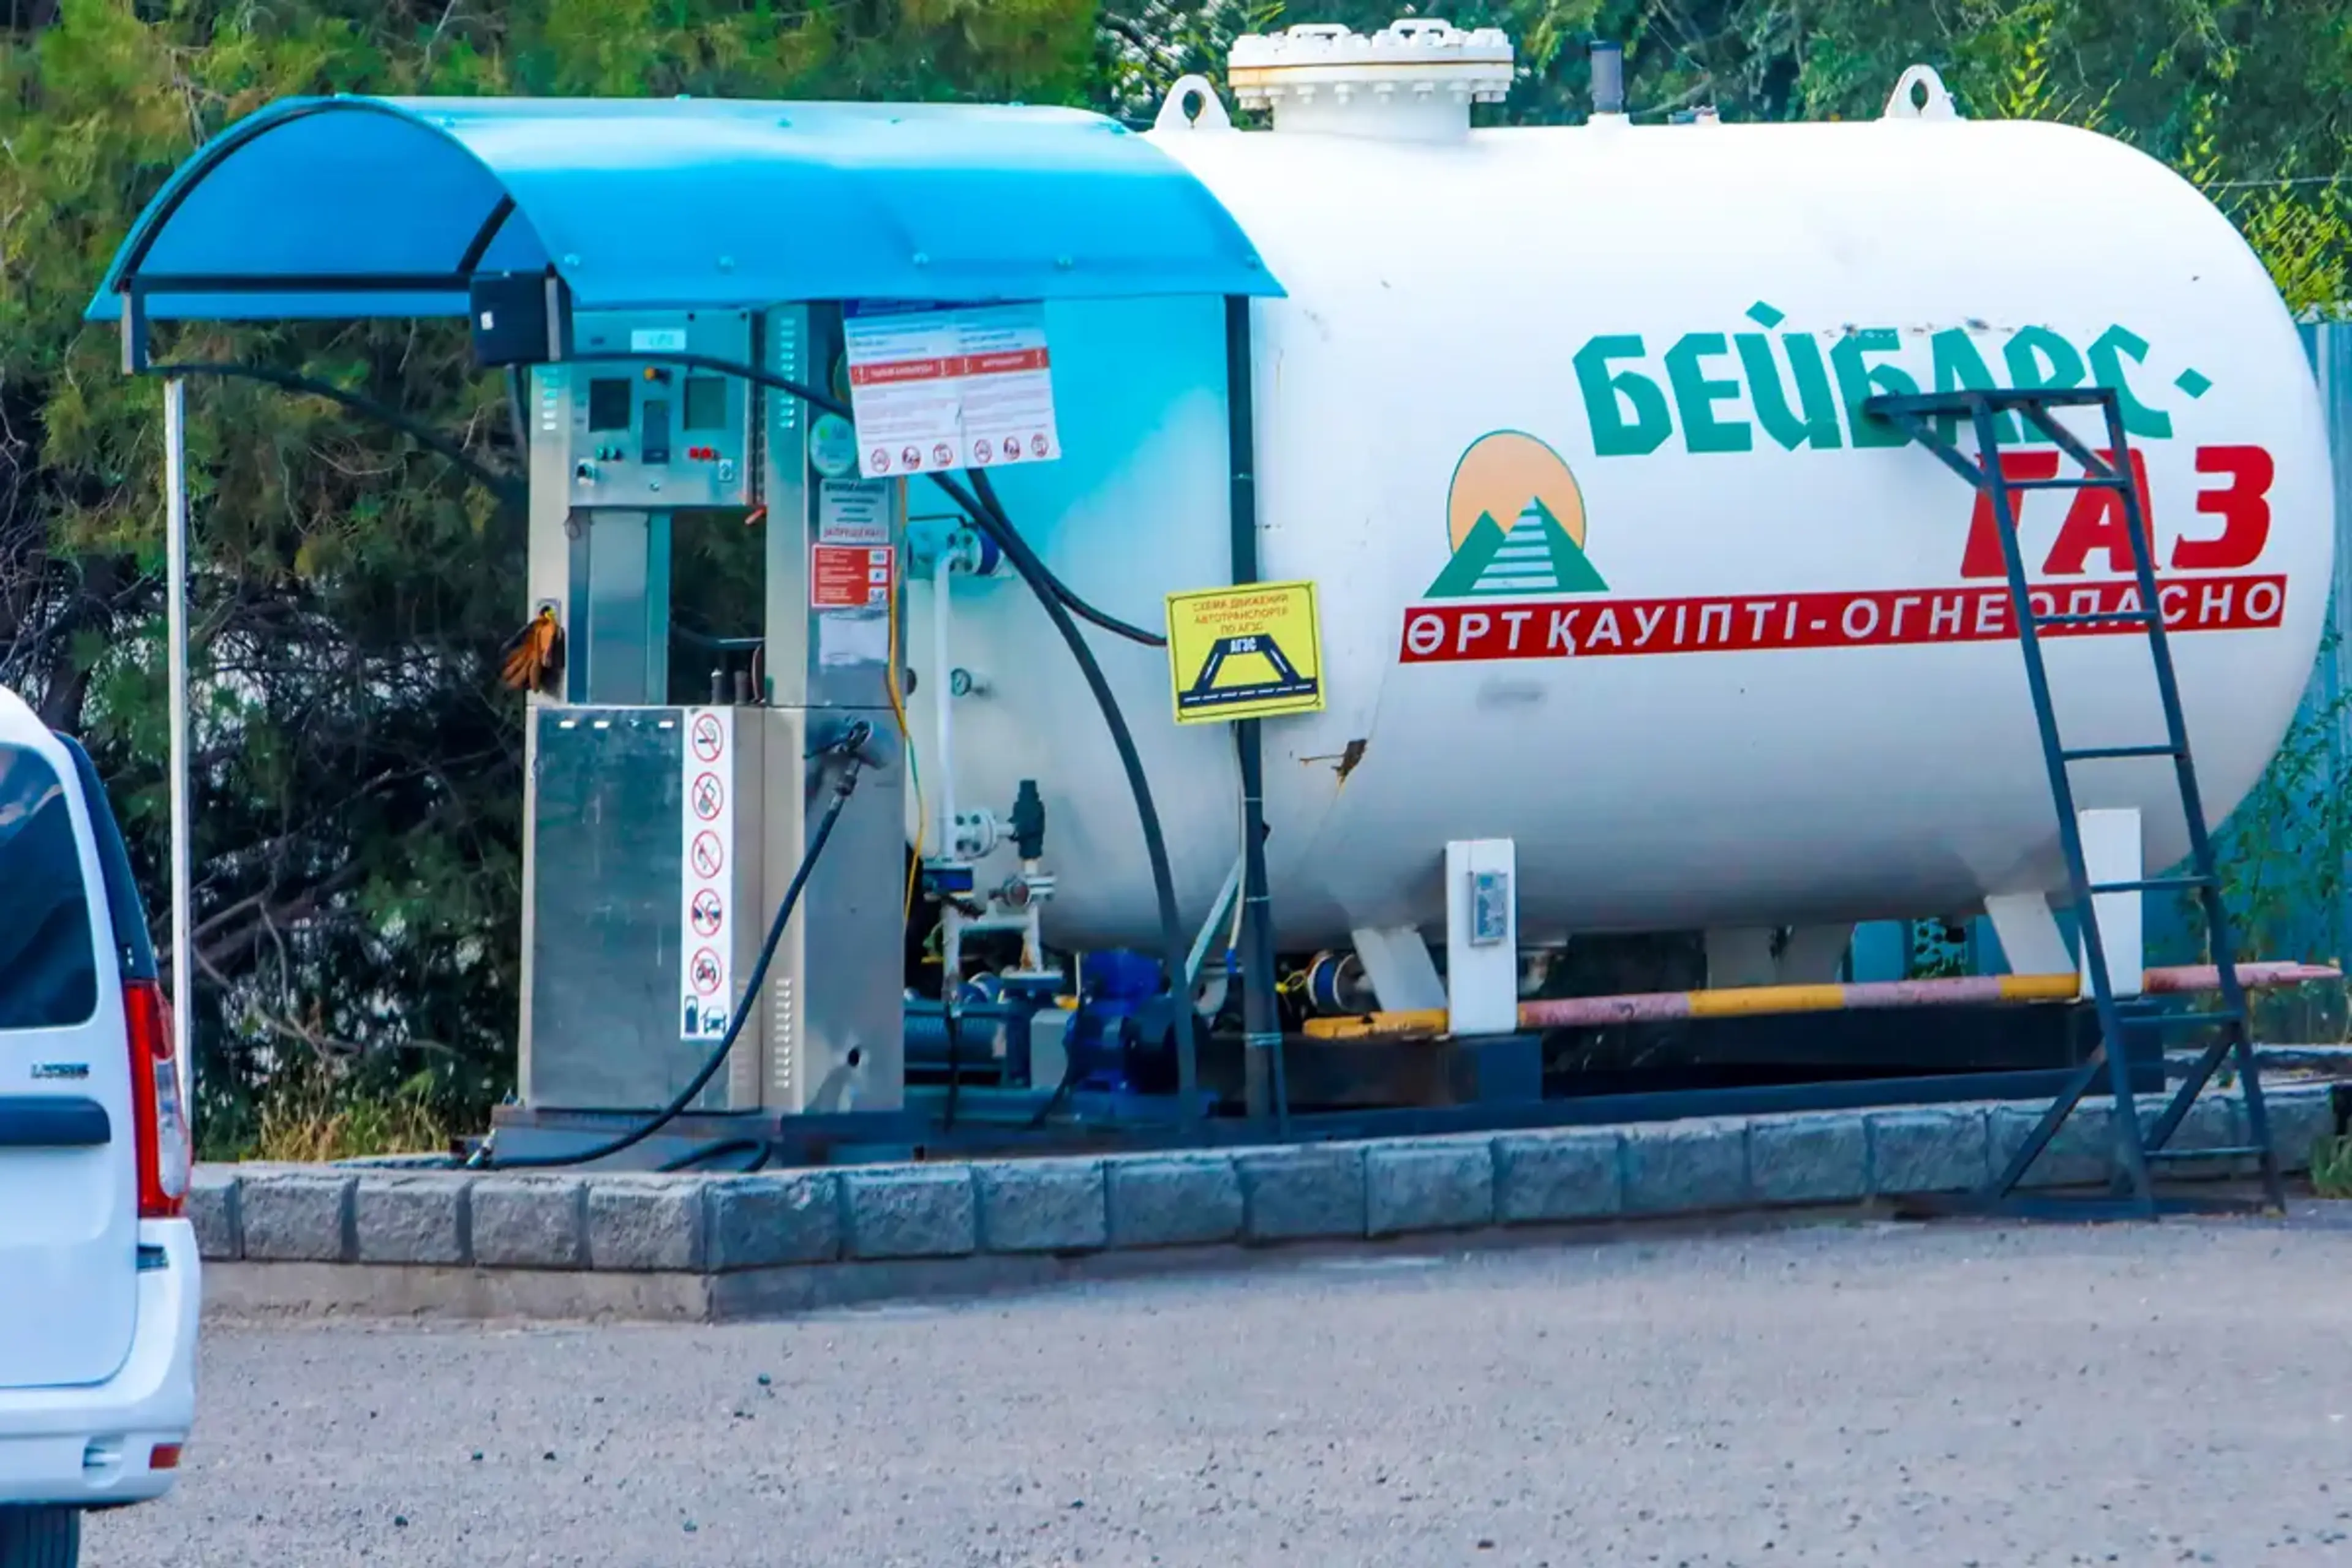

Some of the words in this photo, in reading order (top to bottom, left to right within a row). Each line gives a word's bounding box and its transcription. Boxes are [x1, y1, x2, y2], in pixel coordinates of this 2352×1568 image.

[1959, 445, 2275, 579] ГАЗ
[1230, 636, 1257, 653] АГЗС
[1406, 611, 1532, 655] ӨРТ
